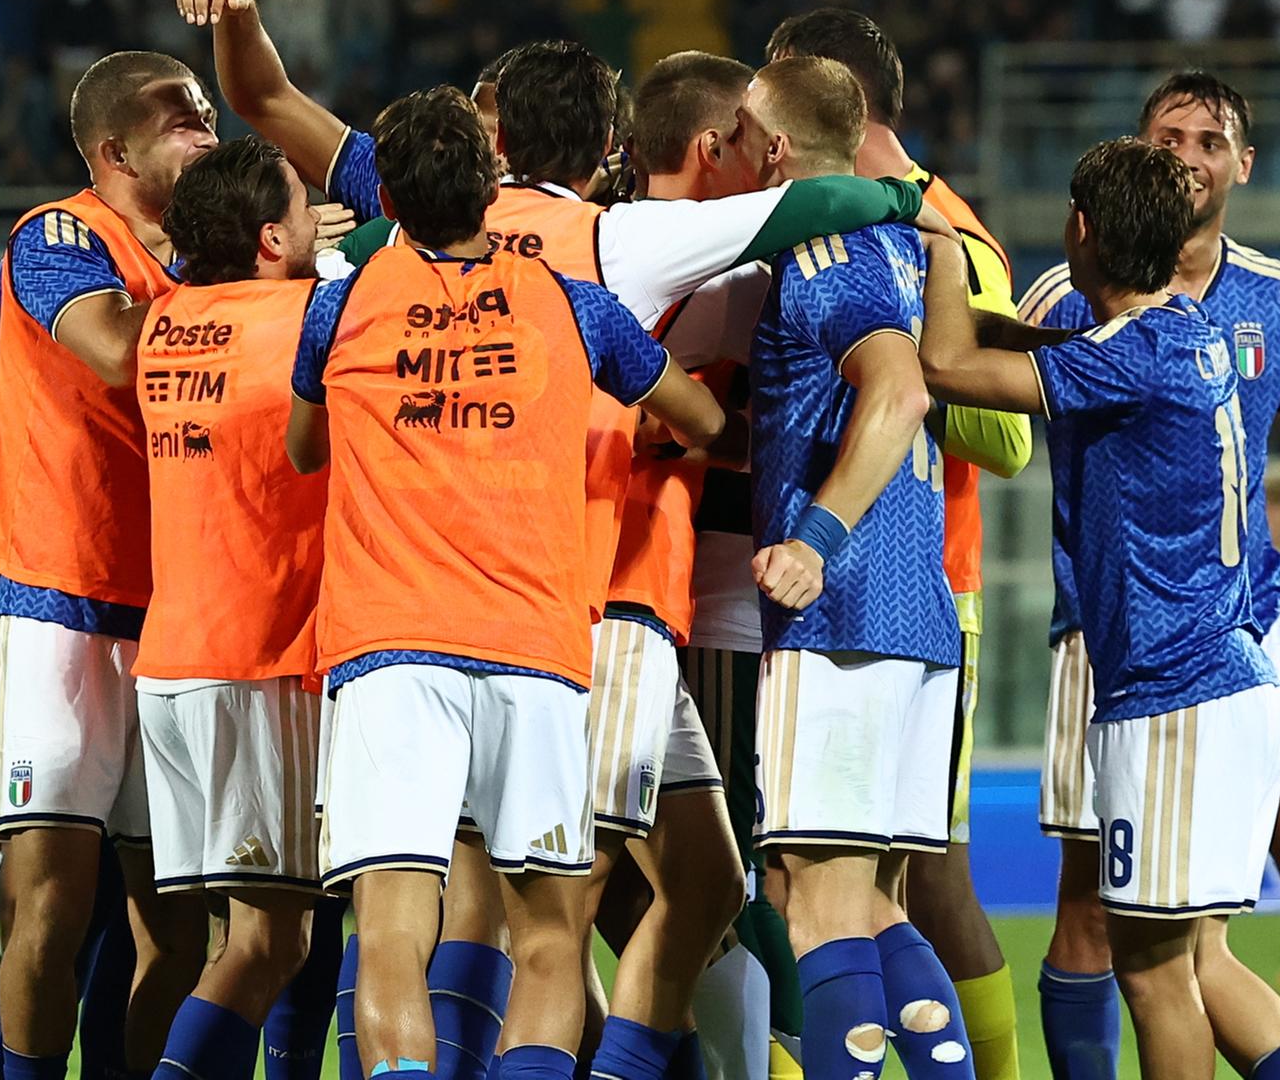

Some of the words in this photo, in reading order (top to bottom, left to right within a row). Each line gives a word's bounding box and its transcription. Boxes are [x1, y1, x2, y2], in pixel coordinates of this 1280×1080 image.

[486, 231, 543, 259] ste
[147, 315, 232, 347] Poste
[175, 371, 227, 404] TIM
[151, 422, 179, 459] eni
